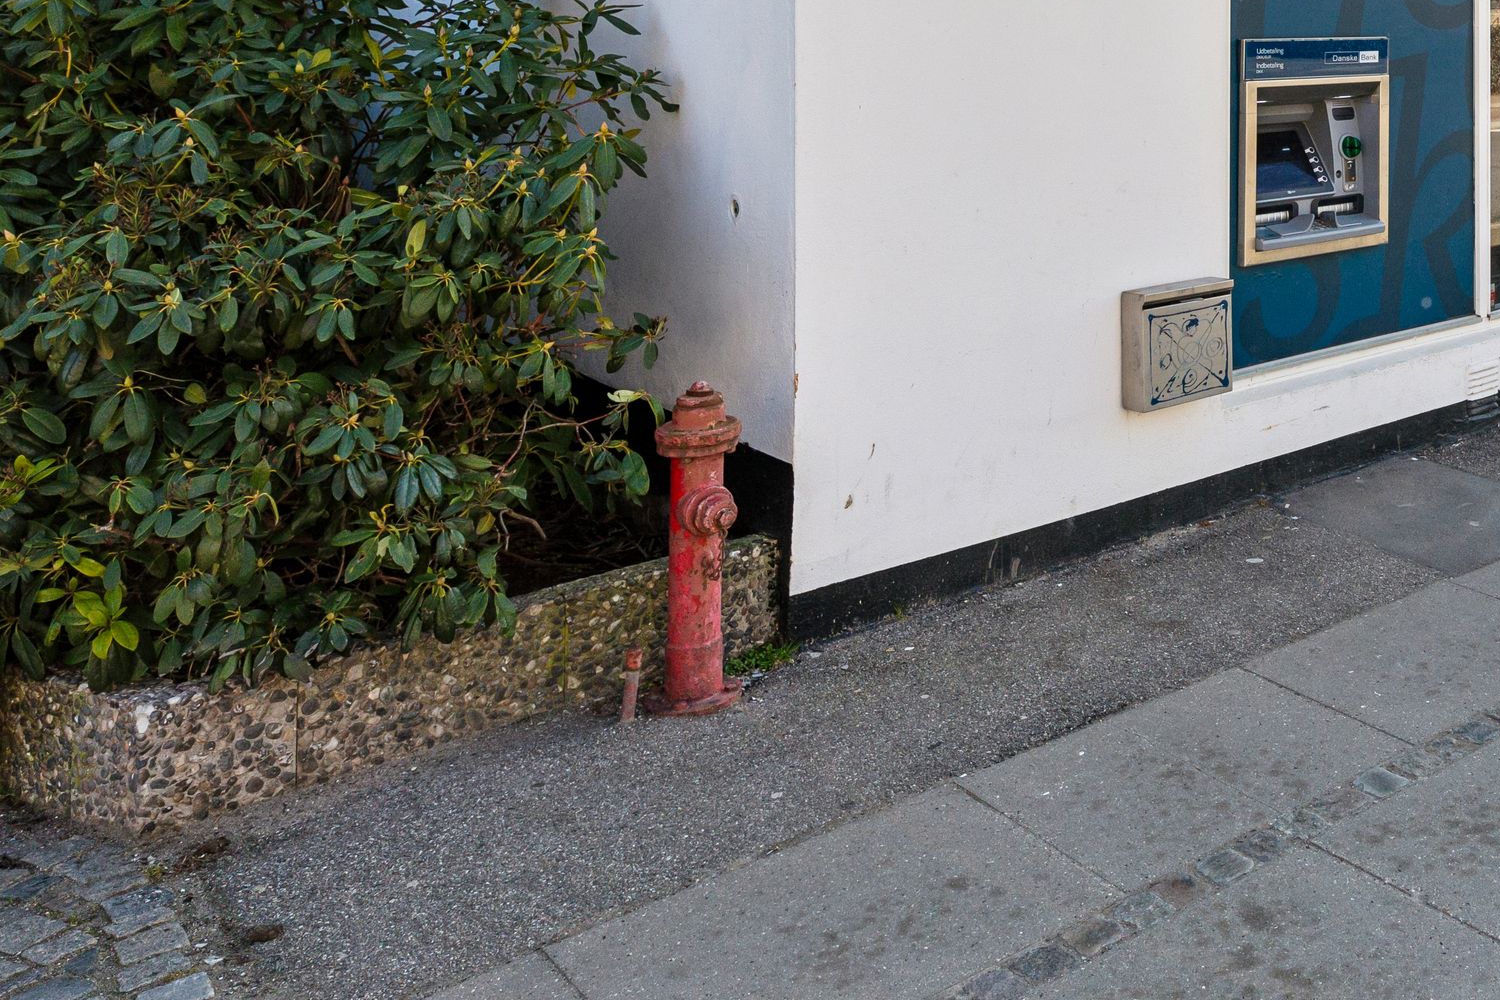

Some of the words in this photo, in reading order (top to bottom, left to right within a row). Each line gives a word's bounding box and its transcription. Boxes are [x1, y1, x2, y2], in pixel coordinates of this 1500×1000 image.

[1332, 54, 1358, 62] Danske
[1361, 53, 1377, 61] Bank
[1256, 62, 1284, 70] Indbetaling
